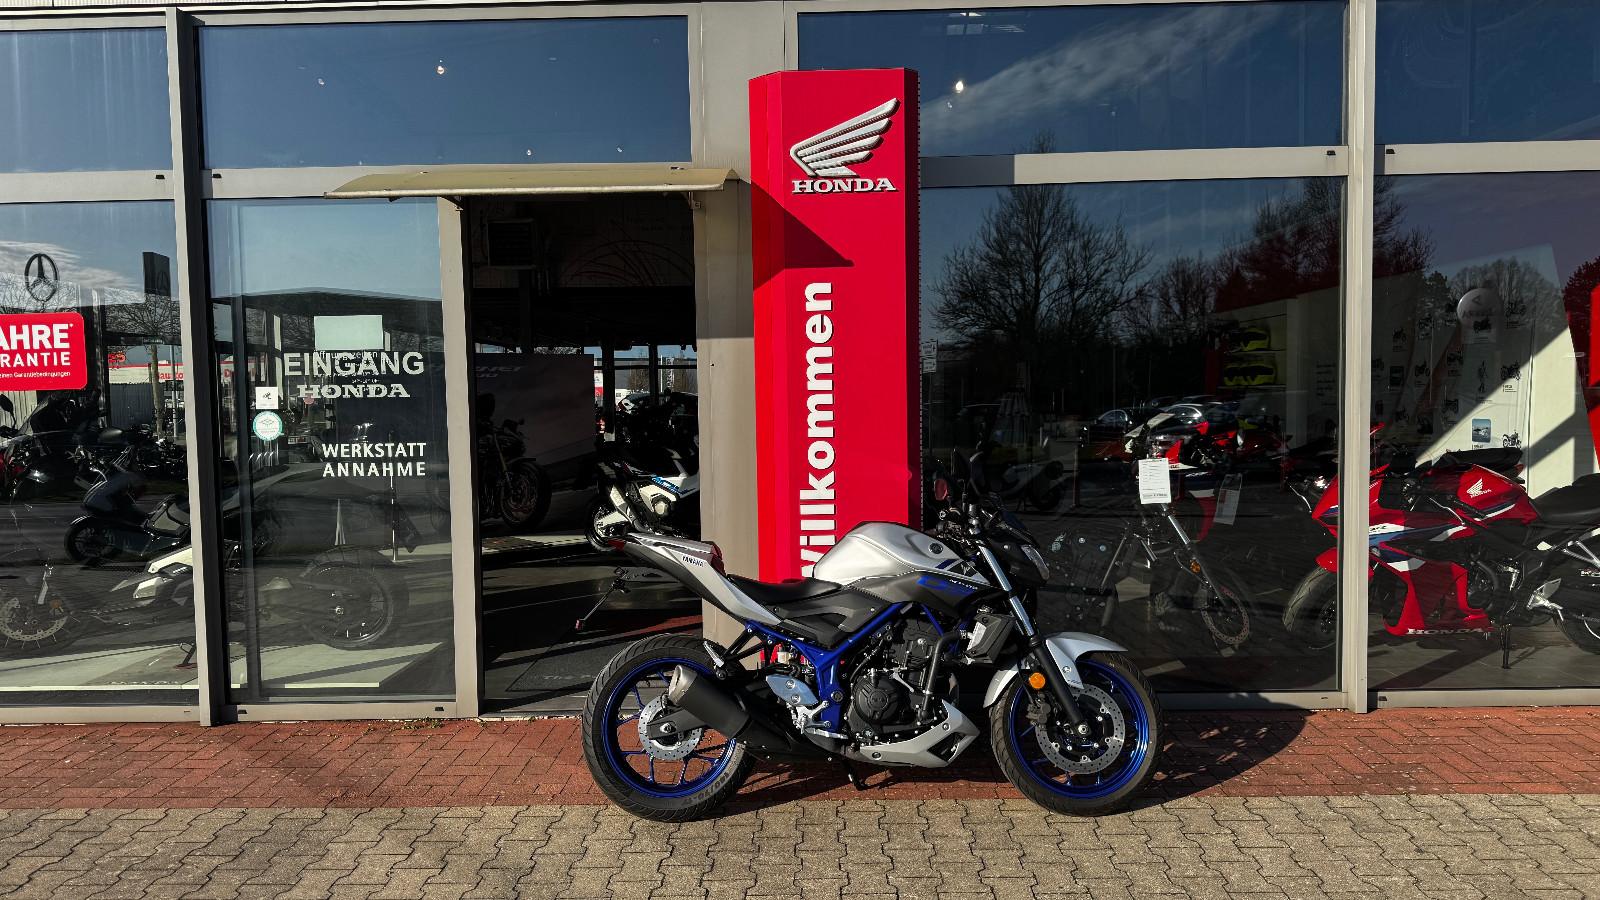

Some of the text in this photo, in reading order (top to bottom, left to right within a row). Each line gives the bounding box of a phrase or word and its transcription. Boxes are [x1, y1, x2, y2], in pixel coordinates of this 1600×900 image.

[792, 178, 897, 193] HONDA
[0, 351, 71, 368] RANTIE
[284, 351, 425, 376] EINGANG
[297, 383, 411, 399] HONDA
[322, 442, 427, 458] WERKSTATT
[322, 461, 427, 477] ANNAHME
